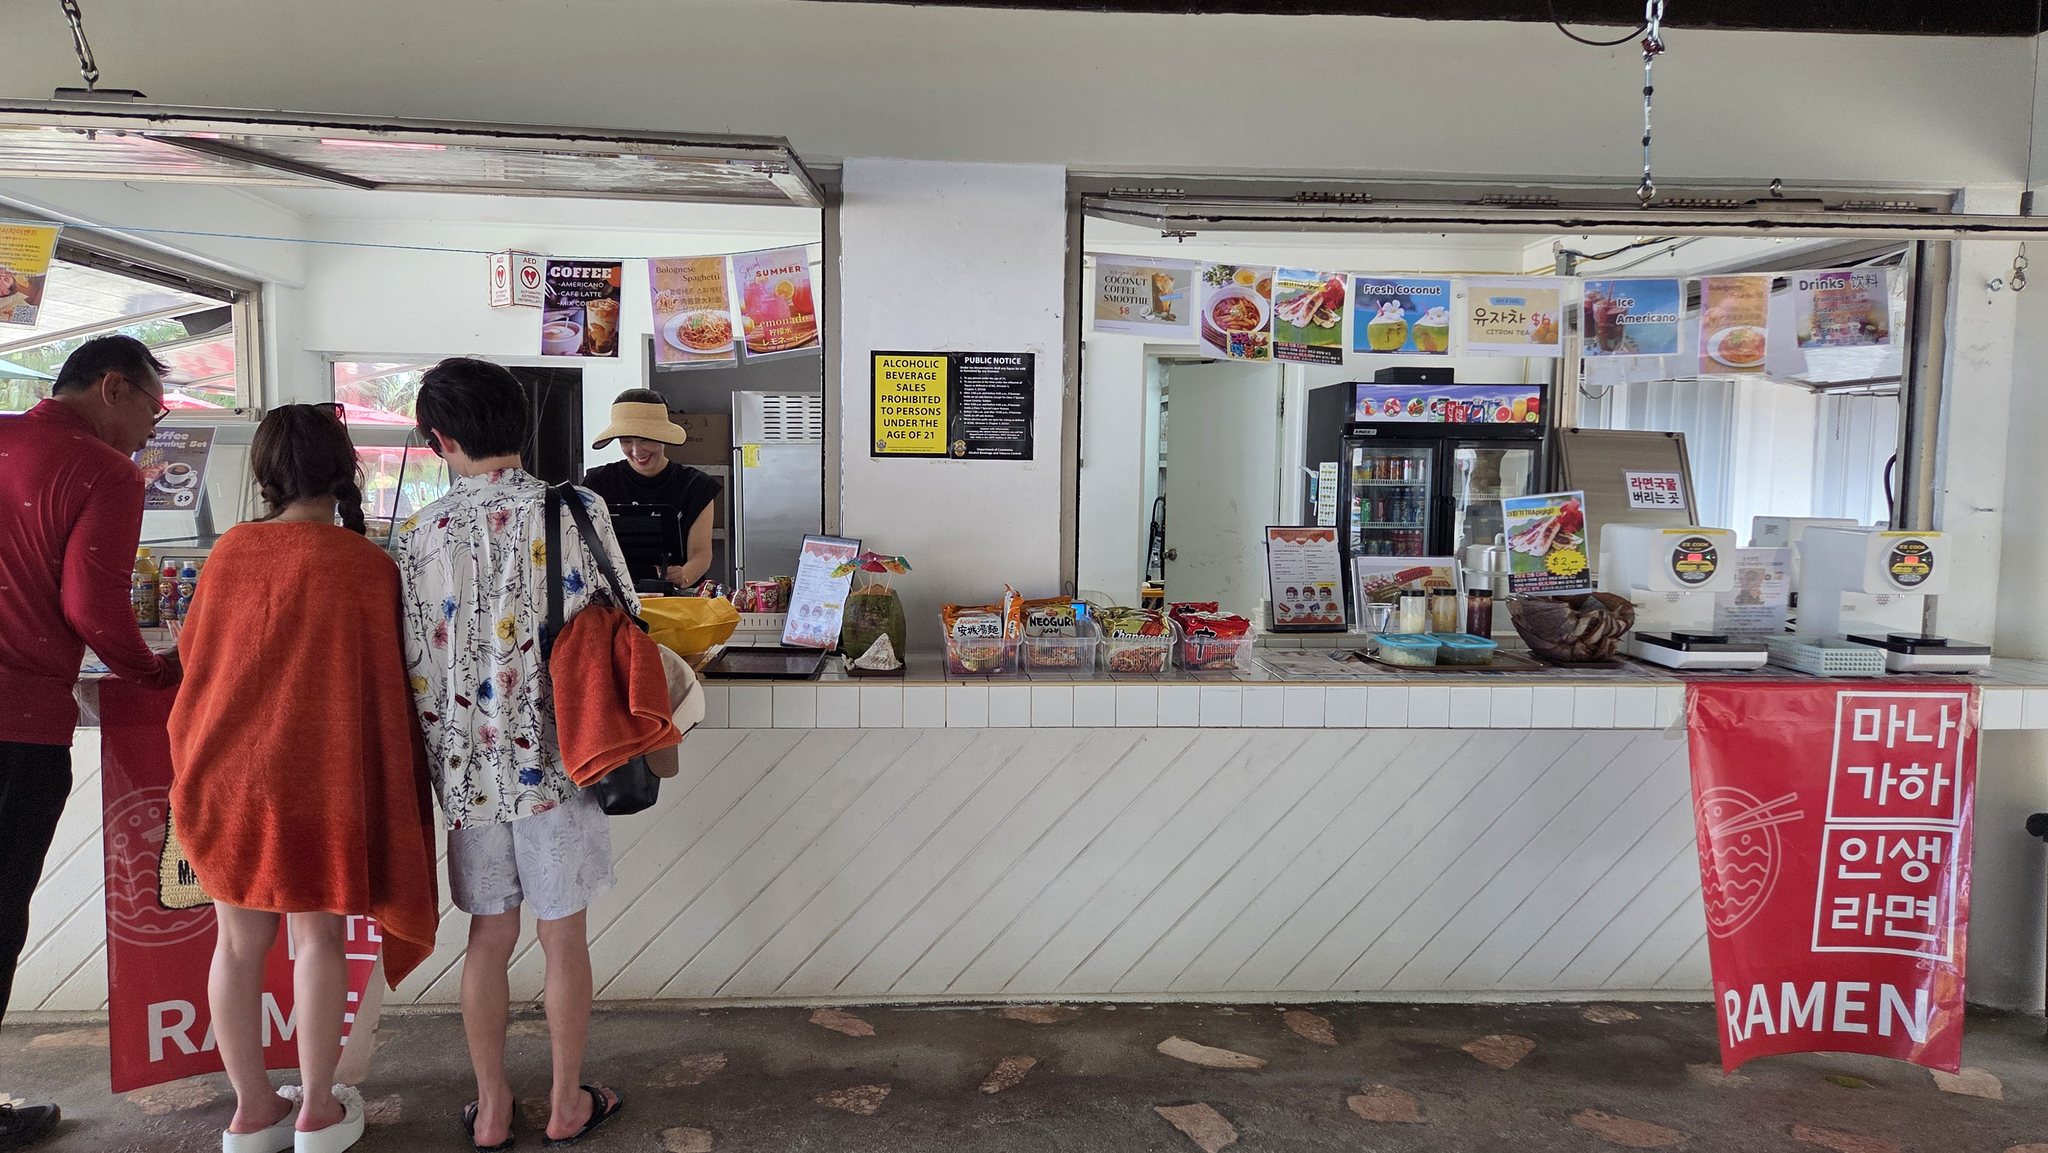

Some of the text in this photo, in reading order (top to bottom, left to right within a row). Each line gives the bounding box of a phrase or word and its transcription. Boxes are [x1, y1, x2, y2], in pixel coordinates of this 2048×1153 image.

[0, 227, 37, 236] 사지이벤트
[522, 257, 536, 265] AED
[550, 266, 612, 279] COFFEE
[656, 266, 696, 274] Bolognese
[756, 265, 801, 277] SUMMER
[682, 273, 720, 282] Spaghetti
[1104, 275, 1147, 286] COCONUT
[1799, 274, 1878, 290] Drinks 饮料
[1104, 284, 1138, 295] COFFEE
[1364, 284, 1441, 295] Fresh Coconut
[1103, 294, 1150, 305] SMOOTHIE
[1617, 299, 1634, 307] Ice
[1119, 306, 1130, 315] $8
[752, 313, 808, 329] Lemonade
[1473, 308, 1550, 327] 유자차 $6
[1616, 314, 1676, 324] Americano
[883, 360, 939, 368] ALCOHOLIC
[886, 372, 937, 380] BEVERAGE
[896, 383, 926, 392] SALES
[881, 395, 941, 404] PROHIBITED
[881, 407, 941, 416] TO PERSONS
[884, 419, 917, 427] UNDER
[156, 431, 189, 440] offee
[887, 431, 906, 439] AGE
[909, 431, 921, 439] OF
[146, 440, 207, 448] Morning Set
[1630, 477, 1677, 491] 라면국물
[1633, 491, 1679, 504] 버리는 곳
[1029, 616, 1073, 627] NEOGURI
[1852, 704, 1956, 749] 마나
[1847, 762, 1950, 806] 가하
[1838, 835, 1941, 883] 인생
[1830, 893, 1937, 941] 라면
[1724, 980, 1928, 1048] RAMEN
